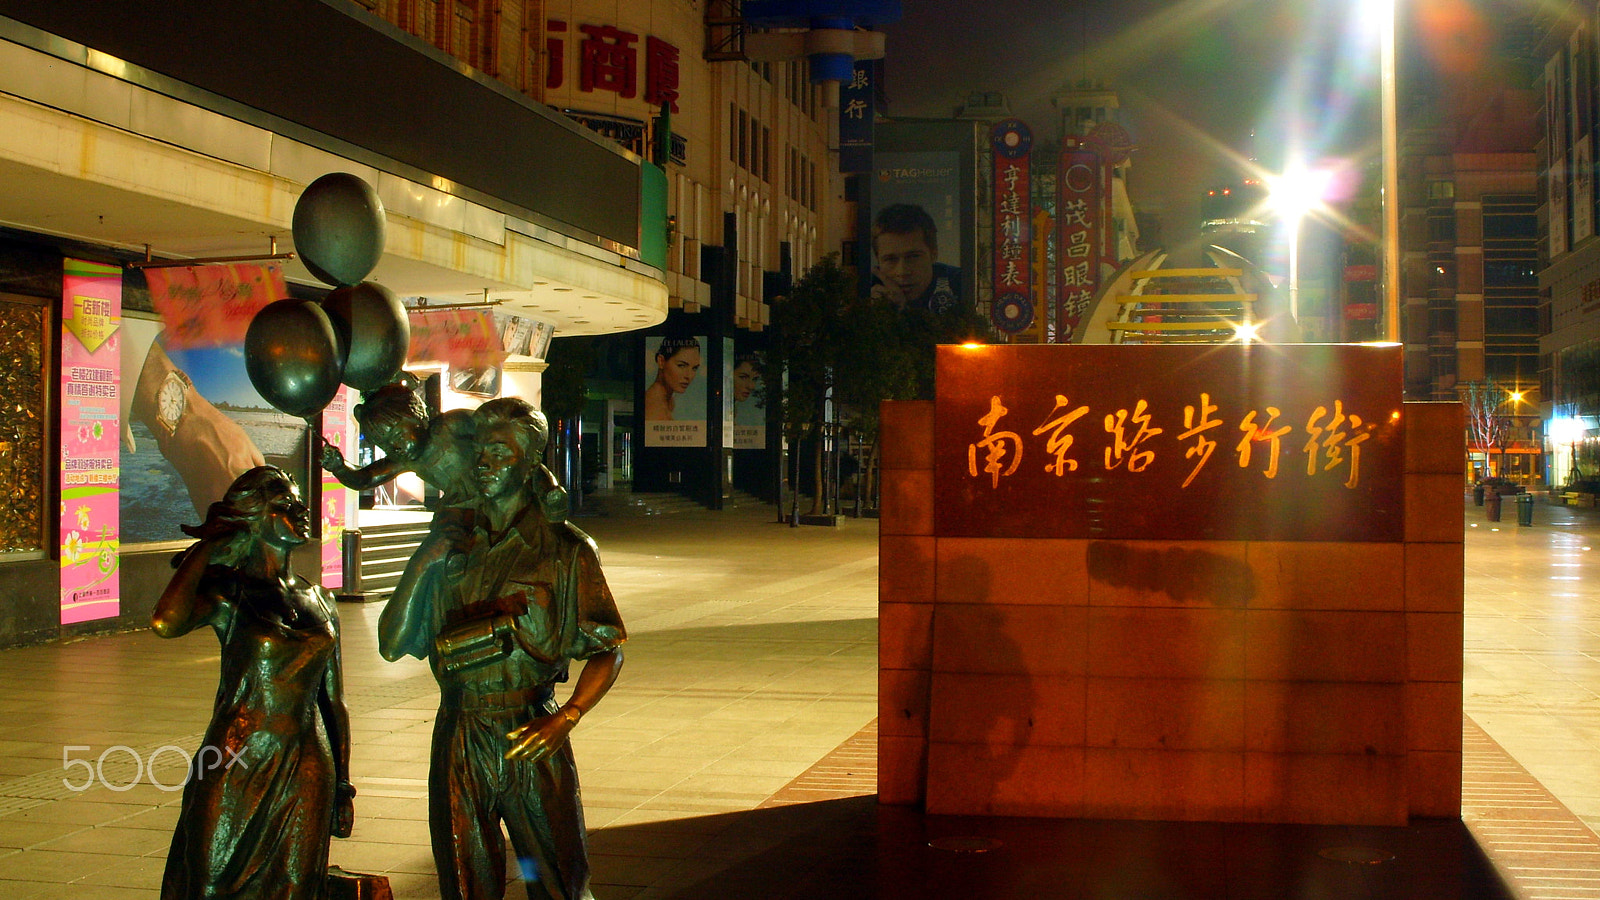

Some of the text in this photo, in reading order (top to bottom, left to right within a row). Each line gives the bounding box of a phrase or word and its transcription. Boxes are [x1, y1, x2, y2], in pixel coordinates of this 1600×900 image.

[844, 69, 869, 120] 銀行
[968, 392, 1371, 490] 南京路步行街
